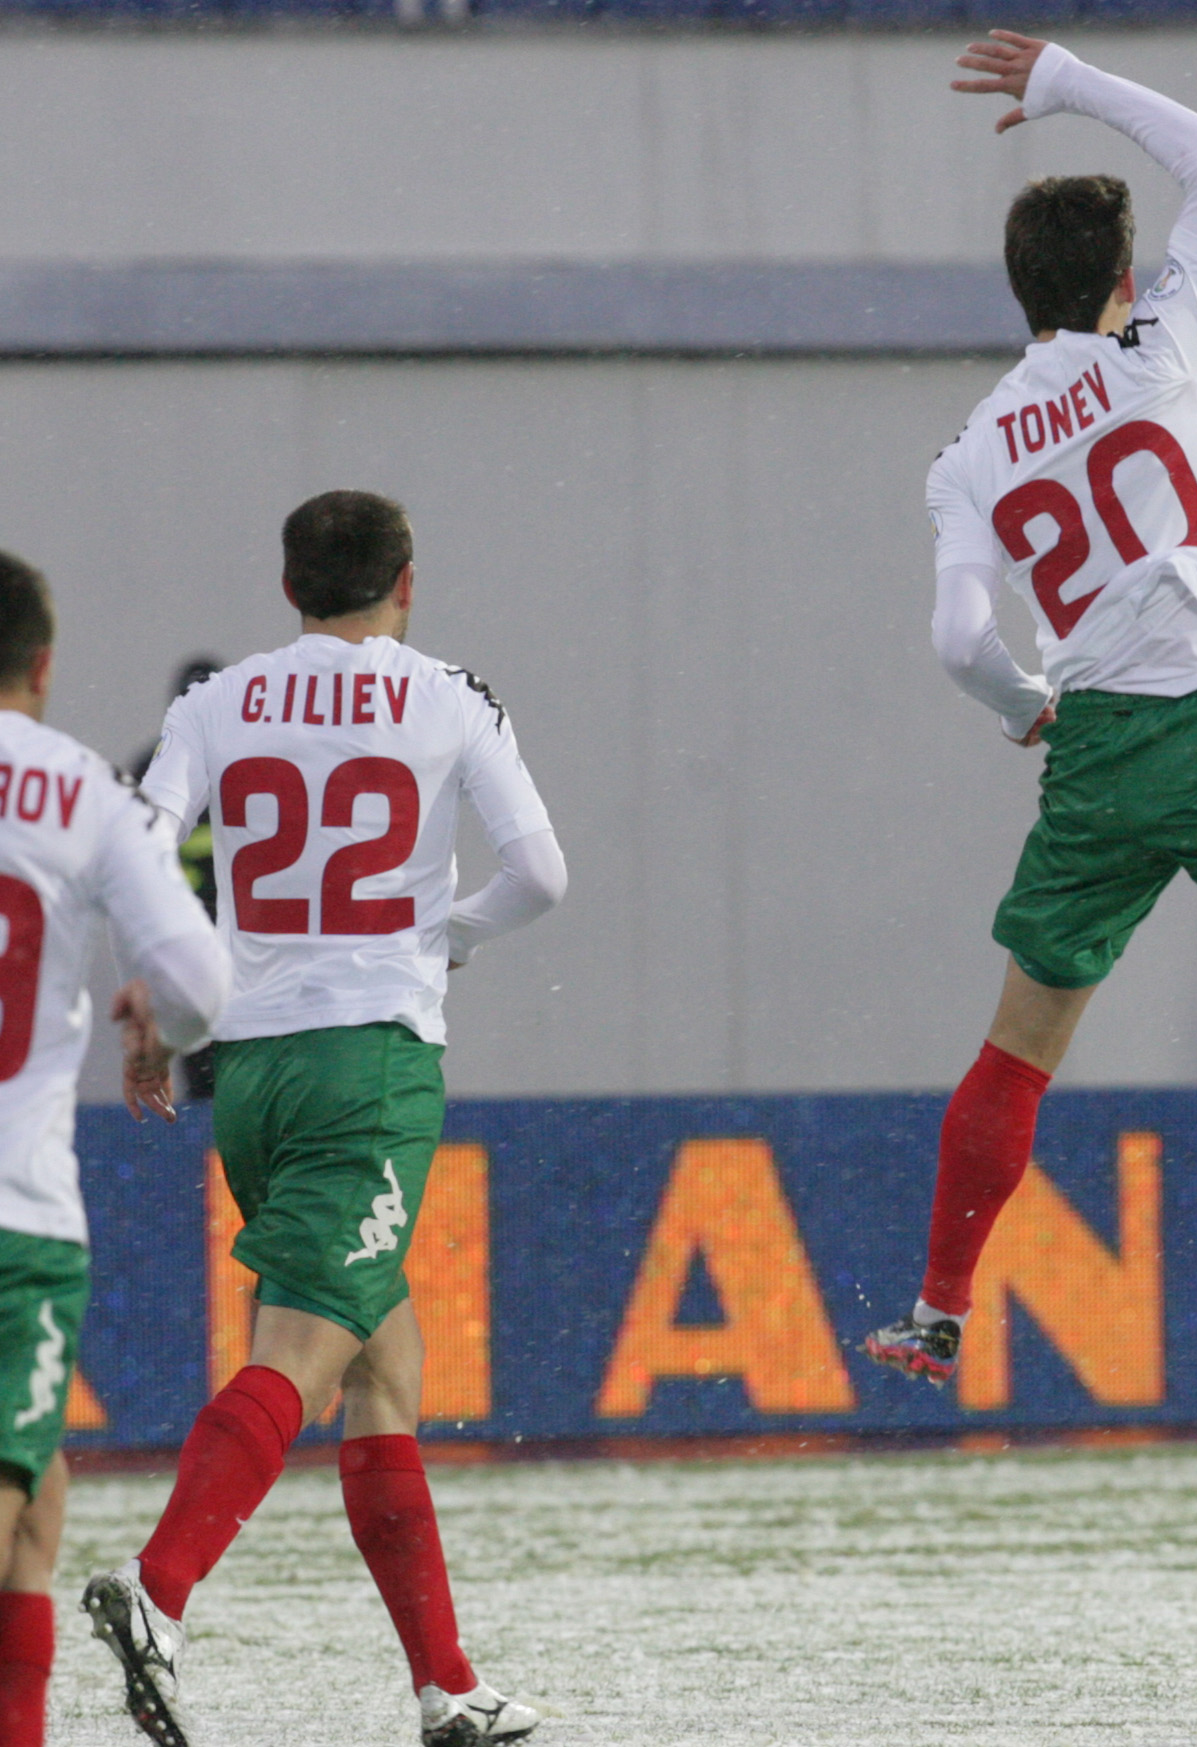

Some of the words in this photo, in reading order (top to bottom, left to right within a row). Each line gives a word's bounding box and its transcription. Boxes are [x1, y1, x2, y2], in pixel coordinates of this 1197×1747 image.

[996, 361, 1112, 465] TONEV
[241, 673, 410, 726] G.ILIEV
[219, 756, 421, 936] 22
